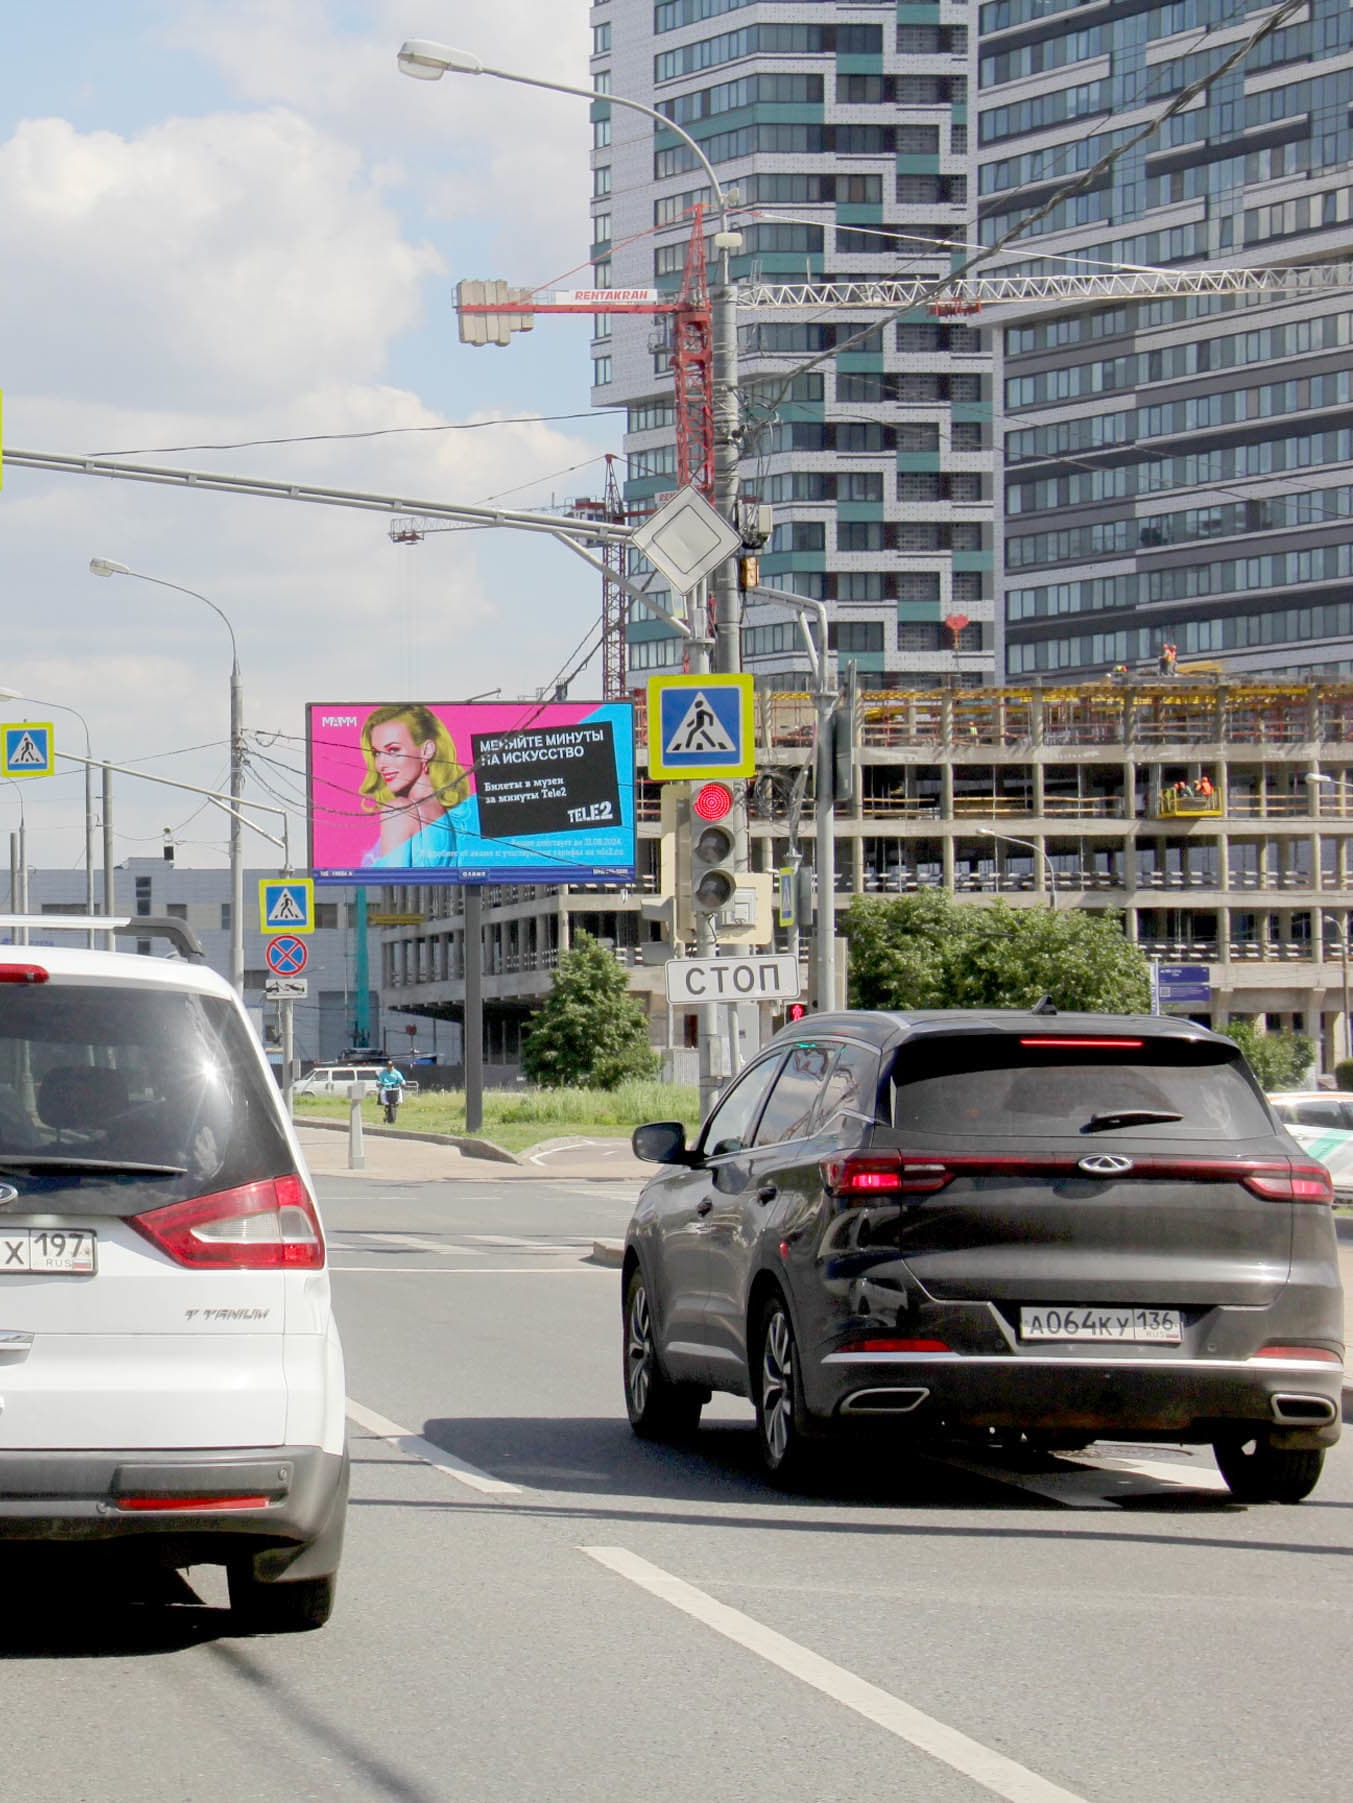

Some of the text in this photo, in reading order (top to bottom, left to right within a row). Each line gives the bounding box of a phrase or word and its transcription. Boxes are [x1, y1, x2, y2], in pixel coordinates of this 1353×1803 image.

[546, 729, 604, 746] МИНУТЫ
[503, 746, 584, 764] ИСКУССТВО
[484, 781, 522, 792] Билеты
[498, 792, 539, 803] минуты
[541, 788, 567, 798] Tele2
[567, 801, 613, 823] TELE2
[685, 964, 780, 995] СТОП
[34, 1233, 84, 1257] 197
[46, 1258, 72, 1268] RUS
[1030, 1311, 1174, 1337] А064КУ 136
